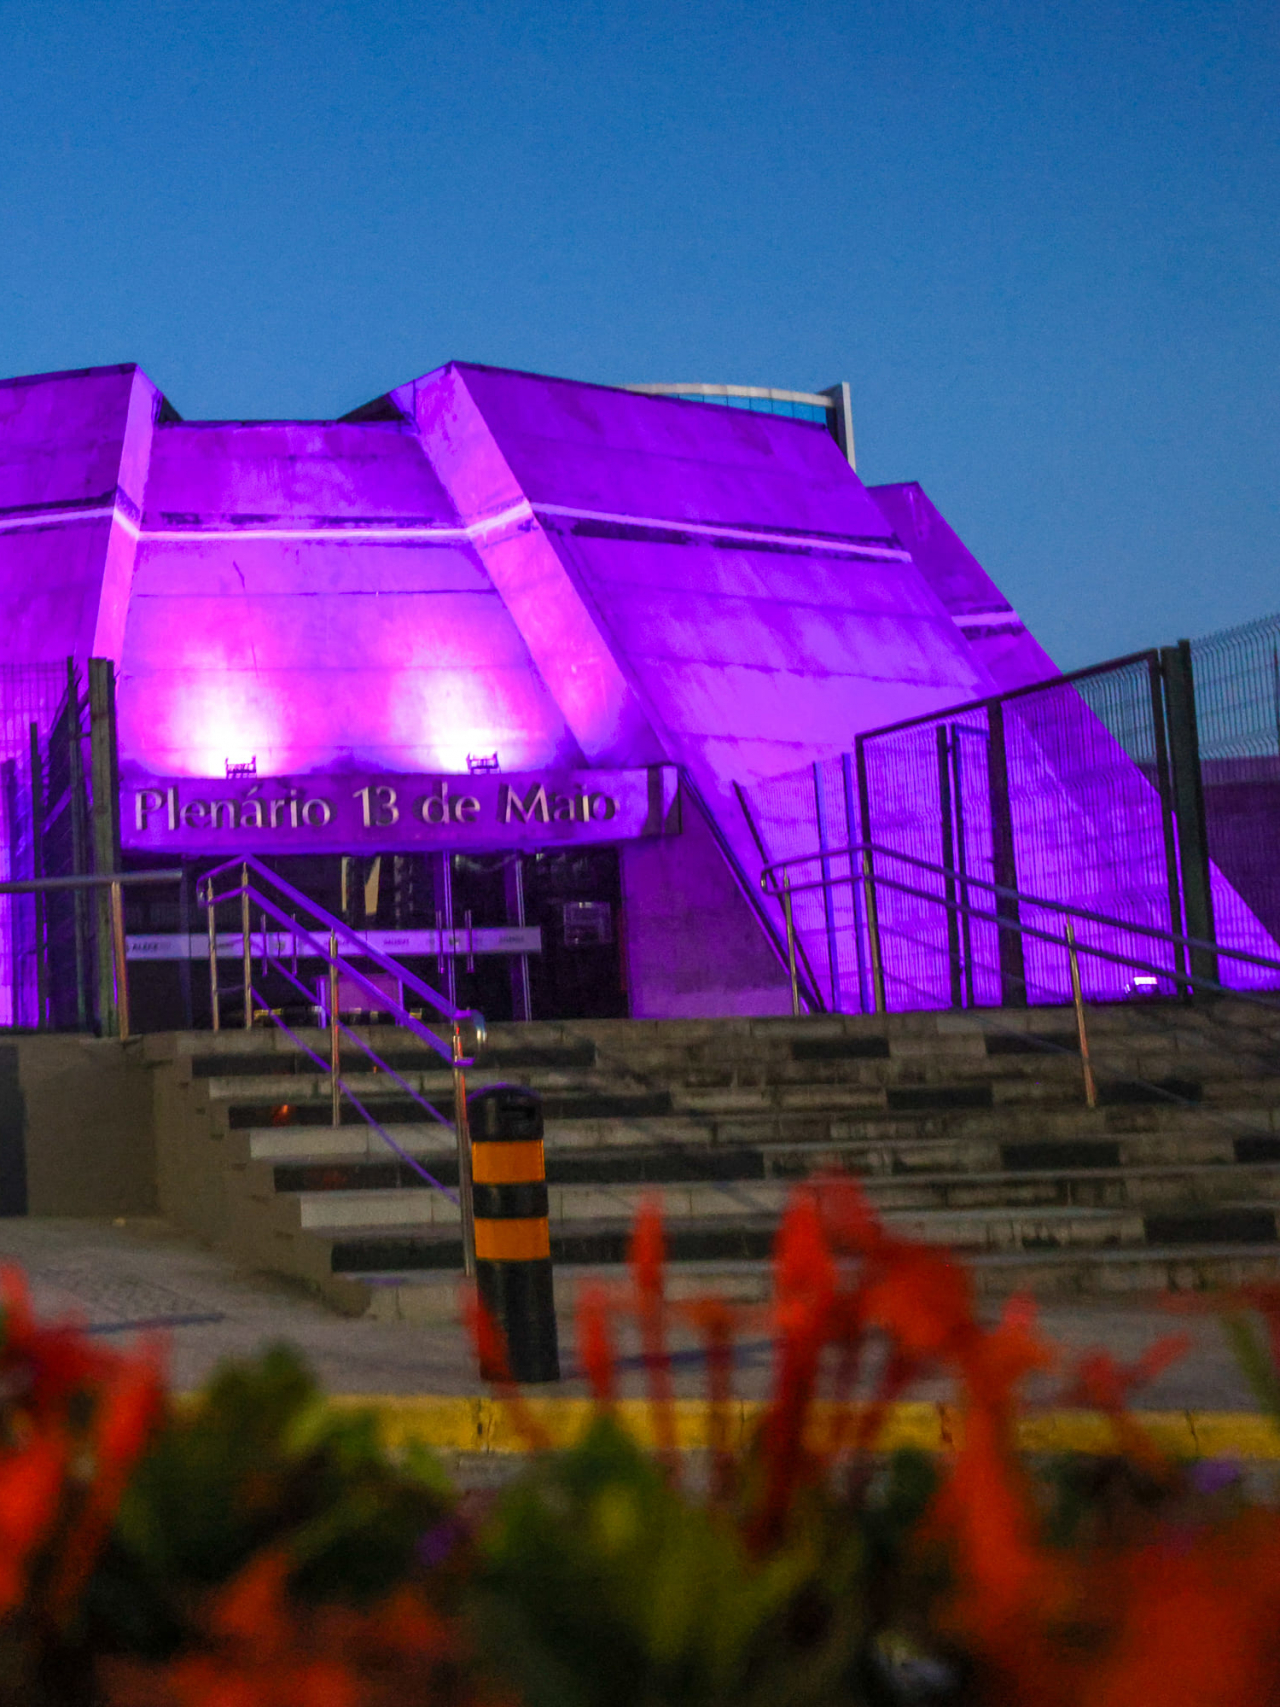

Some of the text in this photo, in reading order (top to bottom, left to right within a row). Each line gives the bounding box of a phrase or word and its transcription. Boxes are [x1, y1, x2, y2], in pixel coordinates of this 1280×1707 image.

[135, 782, 621, 831] Plenário 13 de Maio
